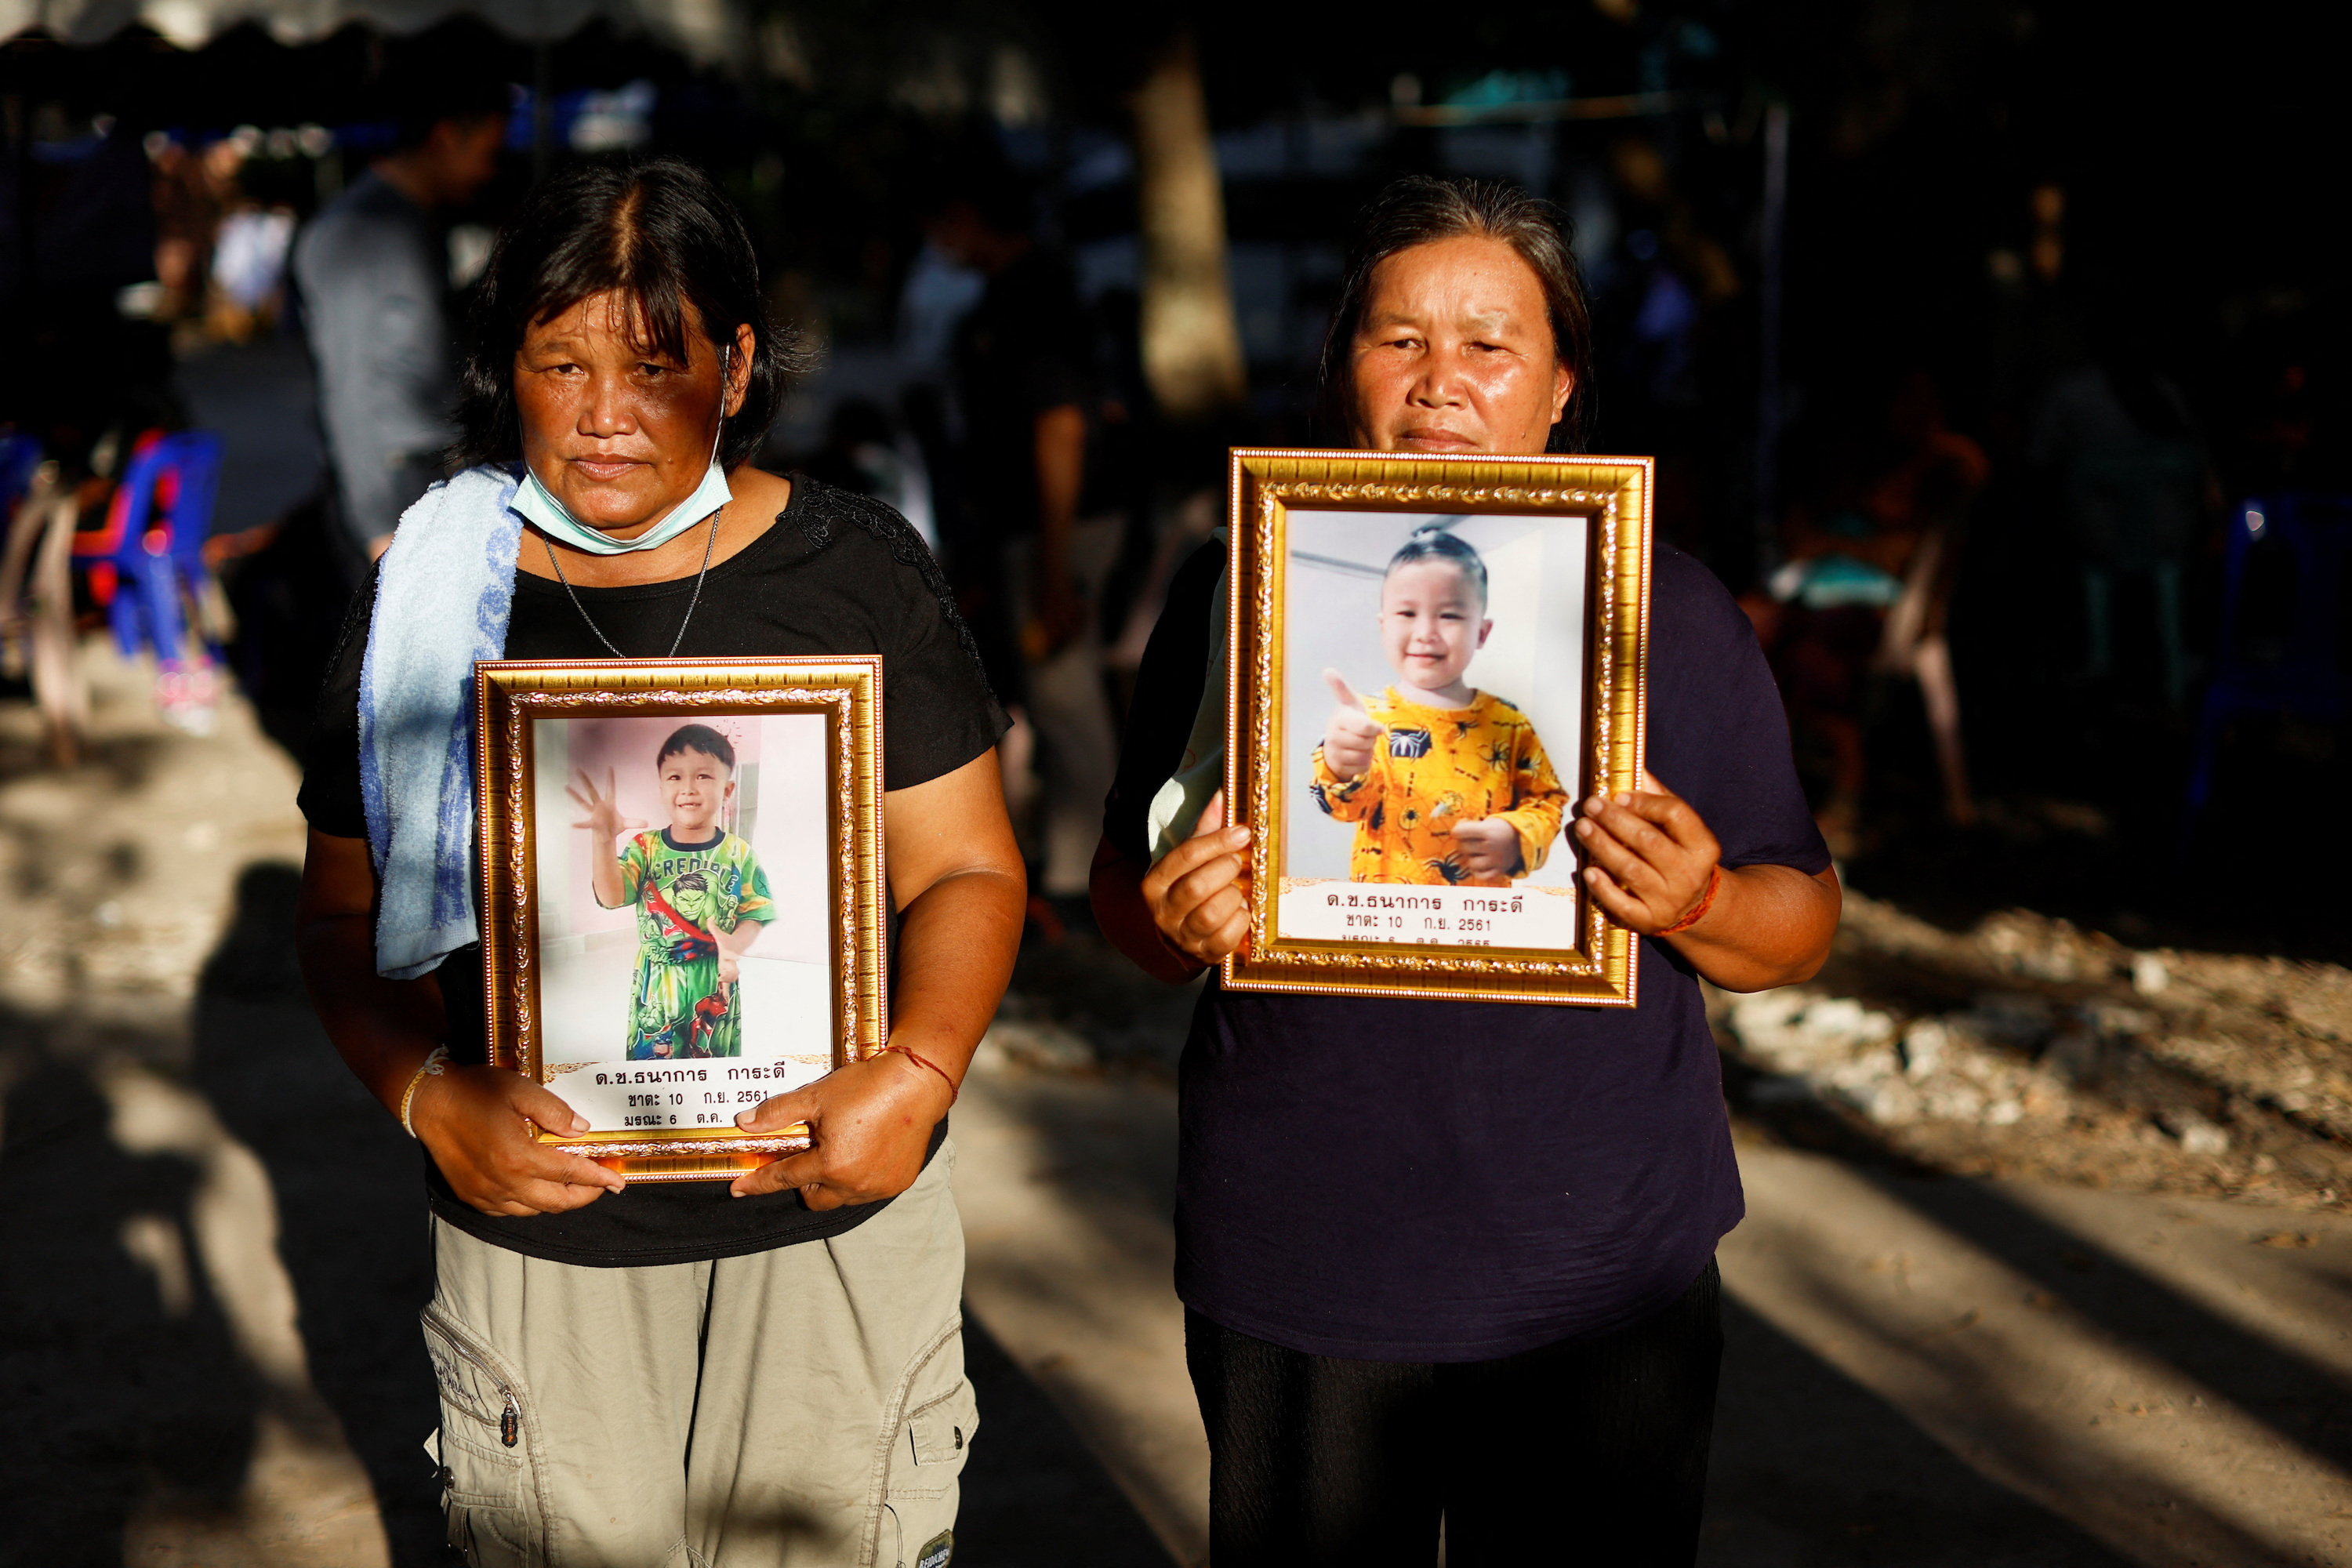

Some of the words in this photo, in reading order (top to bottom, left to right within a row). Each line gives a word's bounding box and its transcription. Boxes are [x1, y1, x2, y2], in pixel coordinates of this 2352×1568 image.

[1327, 893, 1442, 910] ด.ช.ธนาการ
[1463, 895, 1523, 913] การะดี
[1388, 916, 1403, 928] 10
[1424, 917, 1450, 931] ก.ย.
[1458, 919, 1491, 931] 2561
[595, 1069, 707, 1086] ด.ช.ธนาการ
[728, 1061, 785, 1080] การะดี
[669, 1093, 684, 1105] 10
[703, 1091, 730, 1104] ก.ย.
[737, 1090, 768, 1102] 2561
[624, 1114, 662, 1127] มรณะ
[669, 1114, 677, 1125] 6
[696, 1112, 723, 1124] ต.ค.
